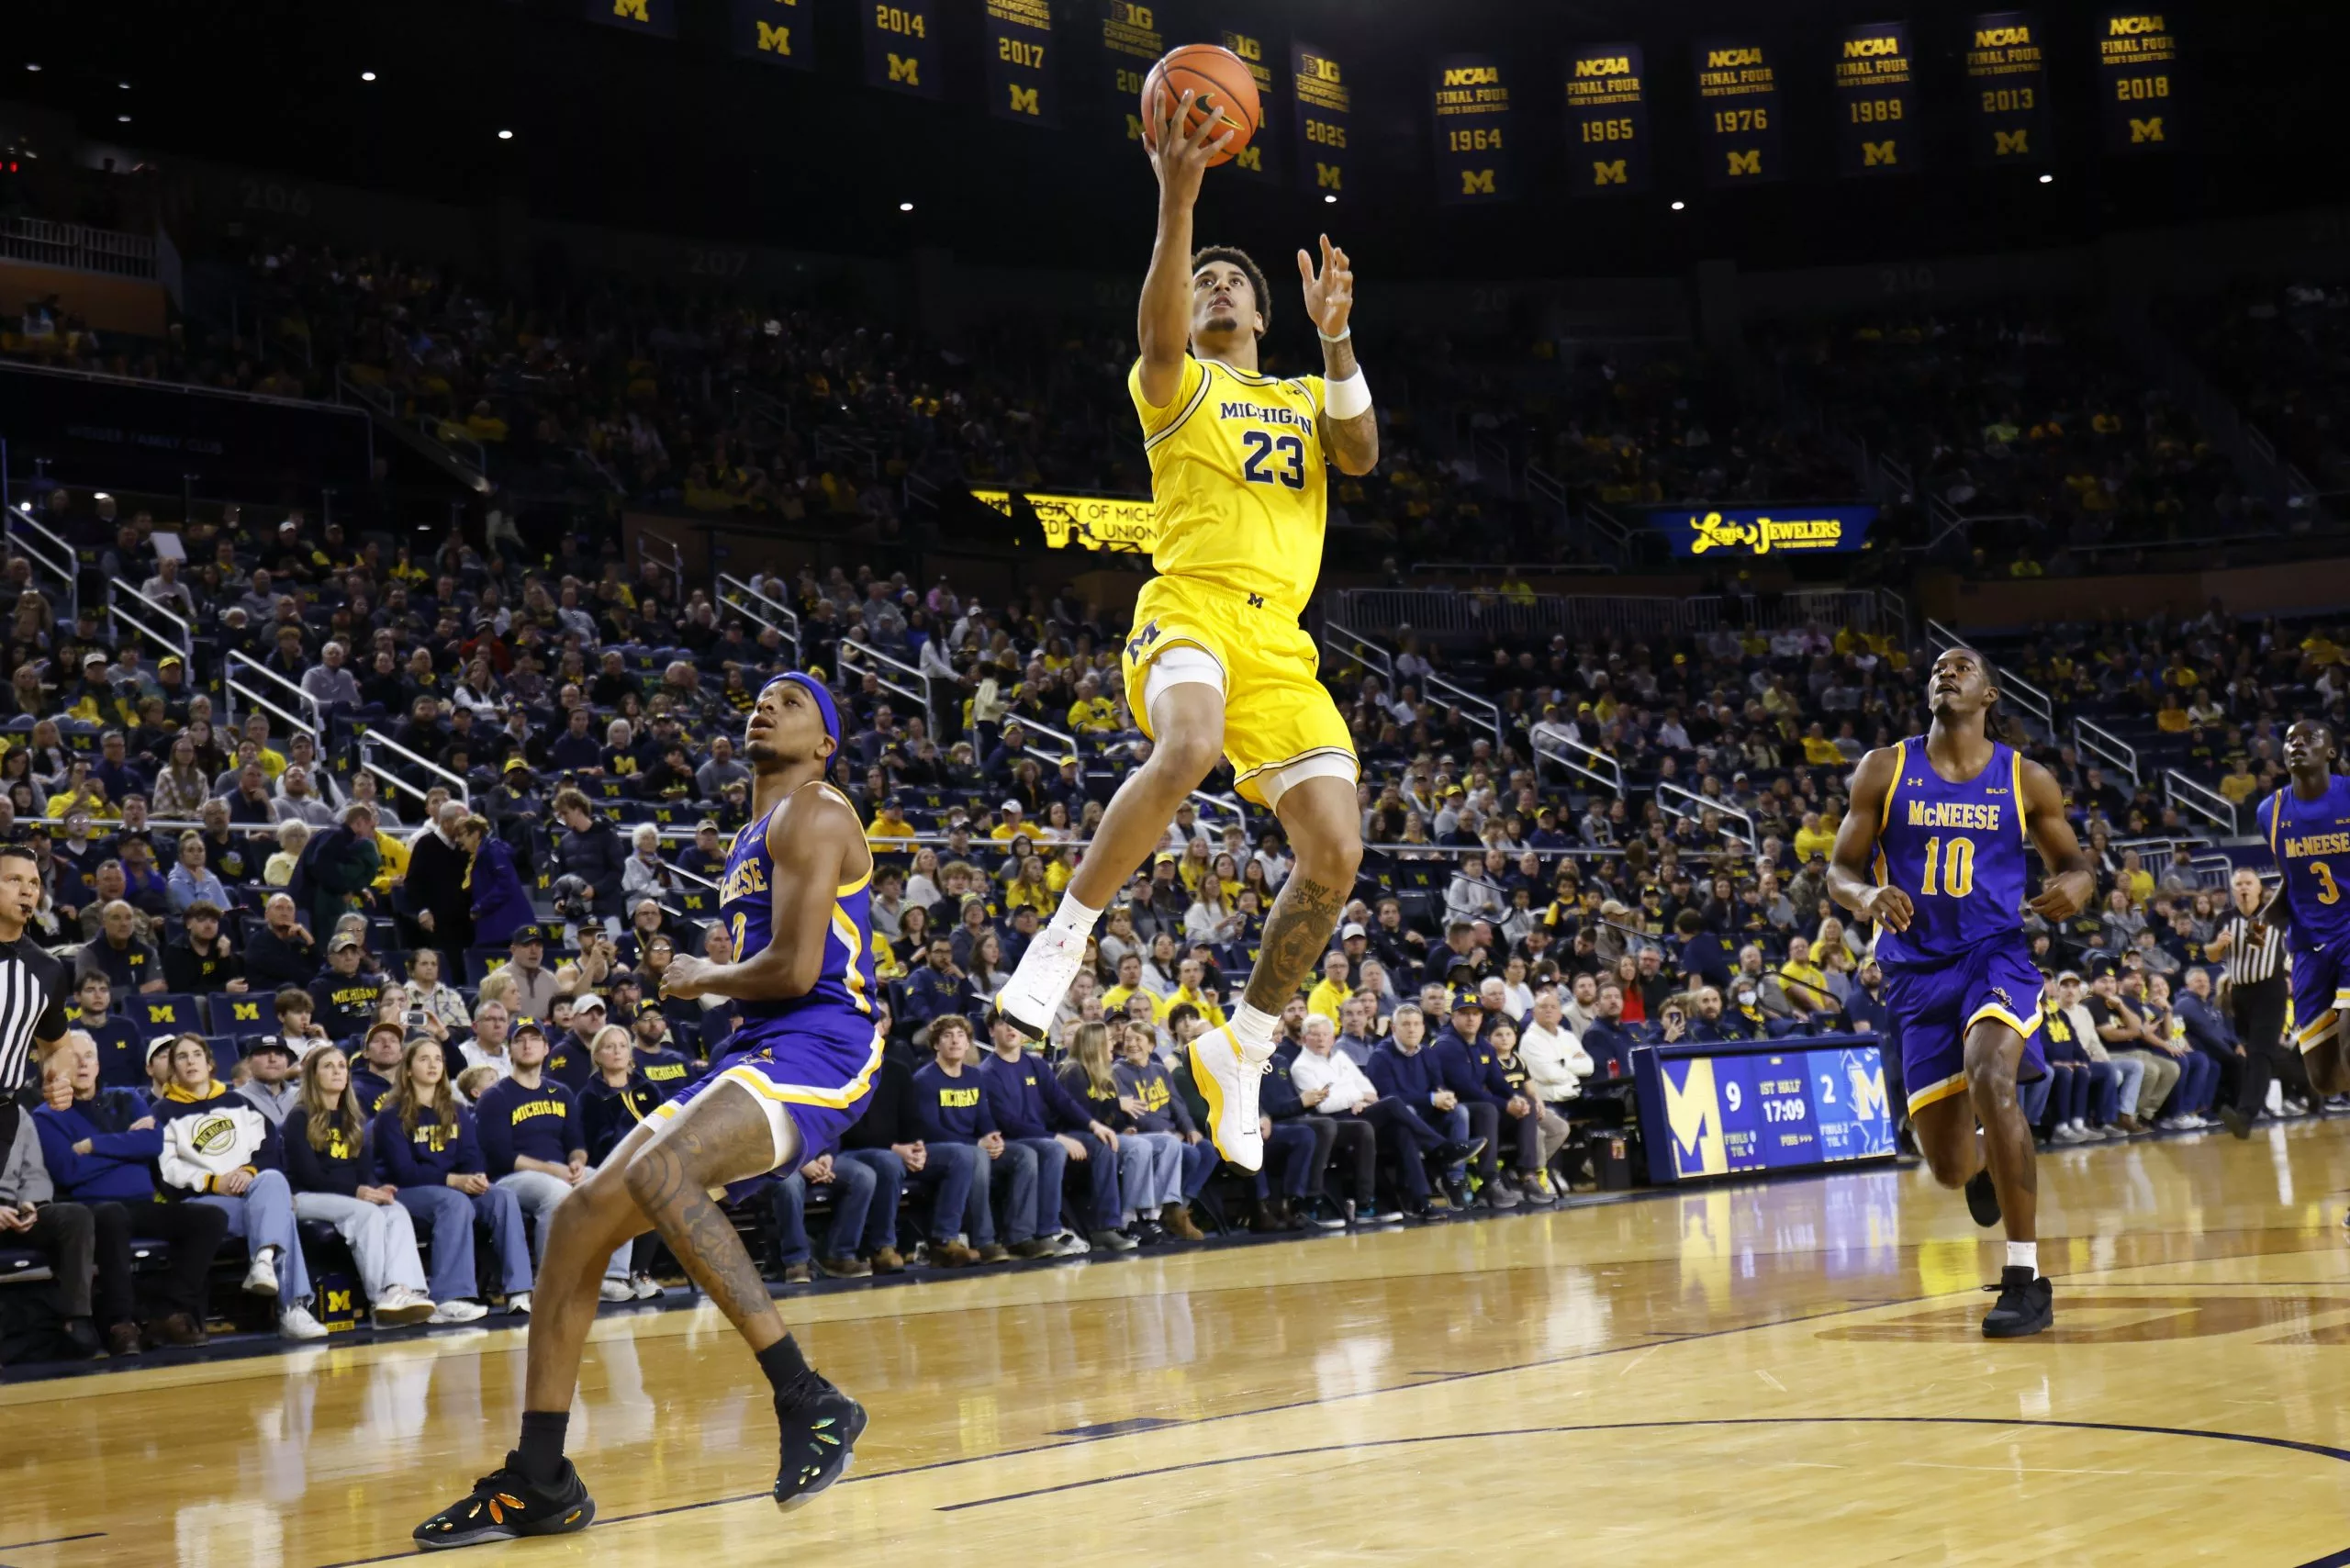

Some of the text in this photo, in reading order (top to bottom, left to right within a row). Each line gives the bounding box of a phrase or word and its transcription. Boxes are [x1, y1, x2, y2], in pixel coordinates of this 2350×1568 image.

[876, 5, 925, 39] 2014
[2109, 15, 2165, 37] NCAA
[756, 20, 790, 55] M
[1843, 36, 1899, 58] NCAA
[1975, 26, 2031, 48] NCAA
[2100, 36, 2176, 54] FINAL FOUR
[999, 37, 1045, 70] 2017
[1707, 47, 1763, 68] NCAA
[1966, 47, 2042, 65] FINAL FOUR
[887, 51, 920, 86] M
[1443, 66, 1499, 86] NCAA
[1574, 56, 1630, 77] NCAA
[1699, 67, 1774, 86] FINAL FOUR
[1836, 58, 1909, 77] FINAL FOUR
[1116, 68, 1144, 95] 201
[1566, 77, 1641, 96] FINAL FOUR
[2116, 75, 2170, 101] 2018
[1009, 83, 1040, 117] M
[1435, 87, 1510, 105] FINAL FOUR
[1981, 88, 2034, 113] 2013
[1714, 108, 1768, 133] 1976
[1850, 98, 1903, 124] 1989
[1305, 118, 1347, 149] 2025
[1449, 129, 1503, 152] 1964
[1582, 118, 1634, 142] 1965
[1993, 129, 2029, 155] M
[2129, 117, 2165, 144] M
[1726, 149, 1762, 176] M
[1862, 140, 1897, 167] M
[1315, 162, 1342, 191] M
[1461, 169, 1496, 195] M
[1593, 158, 1628, 186] M
[1242, 431, 1304, 491] 23
[1088, 504, 1110, 519] OF
[1104, 524, 1158, 540] UNION
[1247, 593, 1264, 610] M
[614, 756, 636, 773] M
[657, 811, 671, 822] M
[1908, 800, 2000, 831] McNEESE
[2285, 833, 2350, 858] McNEESE
[1921, 836, 1975, 898] 10
[2310, 861, 2340, 905] 3
[685, 896, 702, 908] M
[331, 988, 379, 1006] MICHIGAN
[149, 1005, 175, 1023] M
[233, 1002, 260, 1021] M
[643, 1062, 688, 1081] MICHIGAN
[1725, 1081, 1742, 1113] 9
[1777, 1079, 1802, 1094] HALF
[1819, 1074, 1837, 1103] 2
[510, 1099, 566, 1127] MICHIGAN
[1762, 1098, 1806, 1123] 17:09
[330, 1141, 349, 1160] M
[329, 1291, 350, 1311] M
